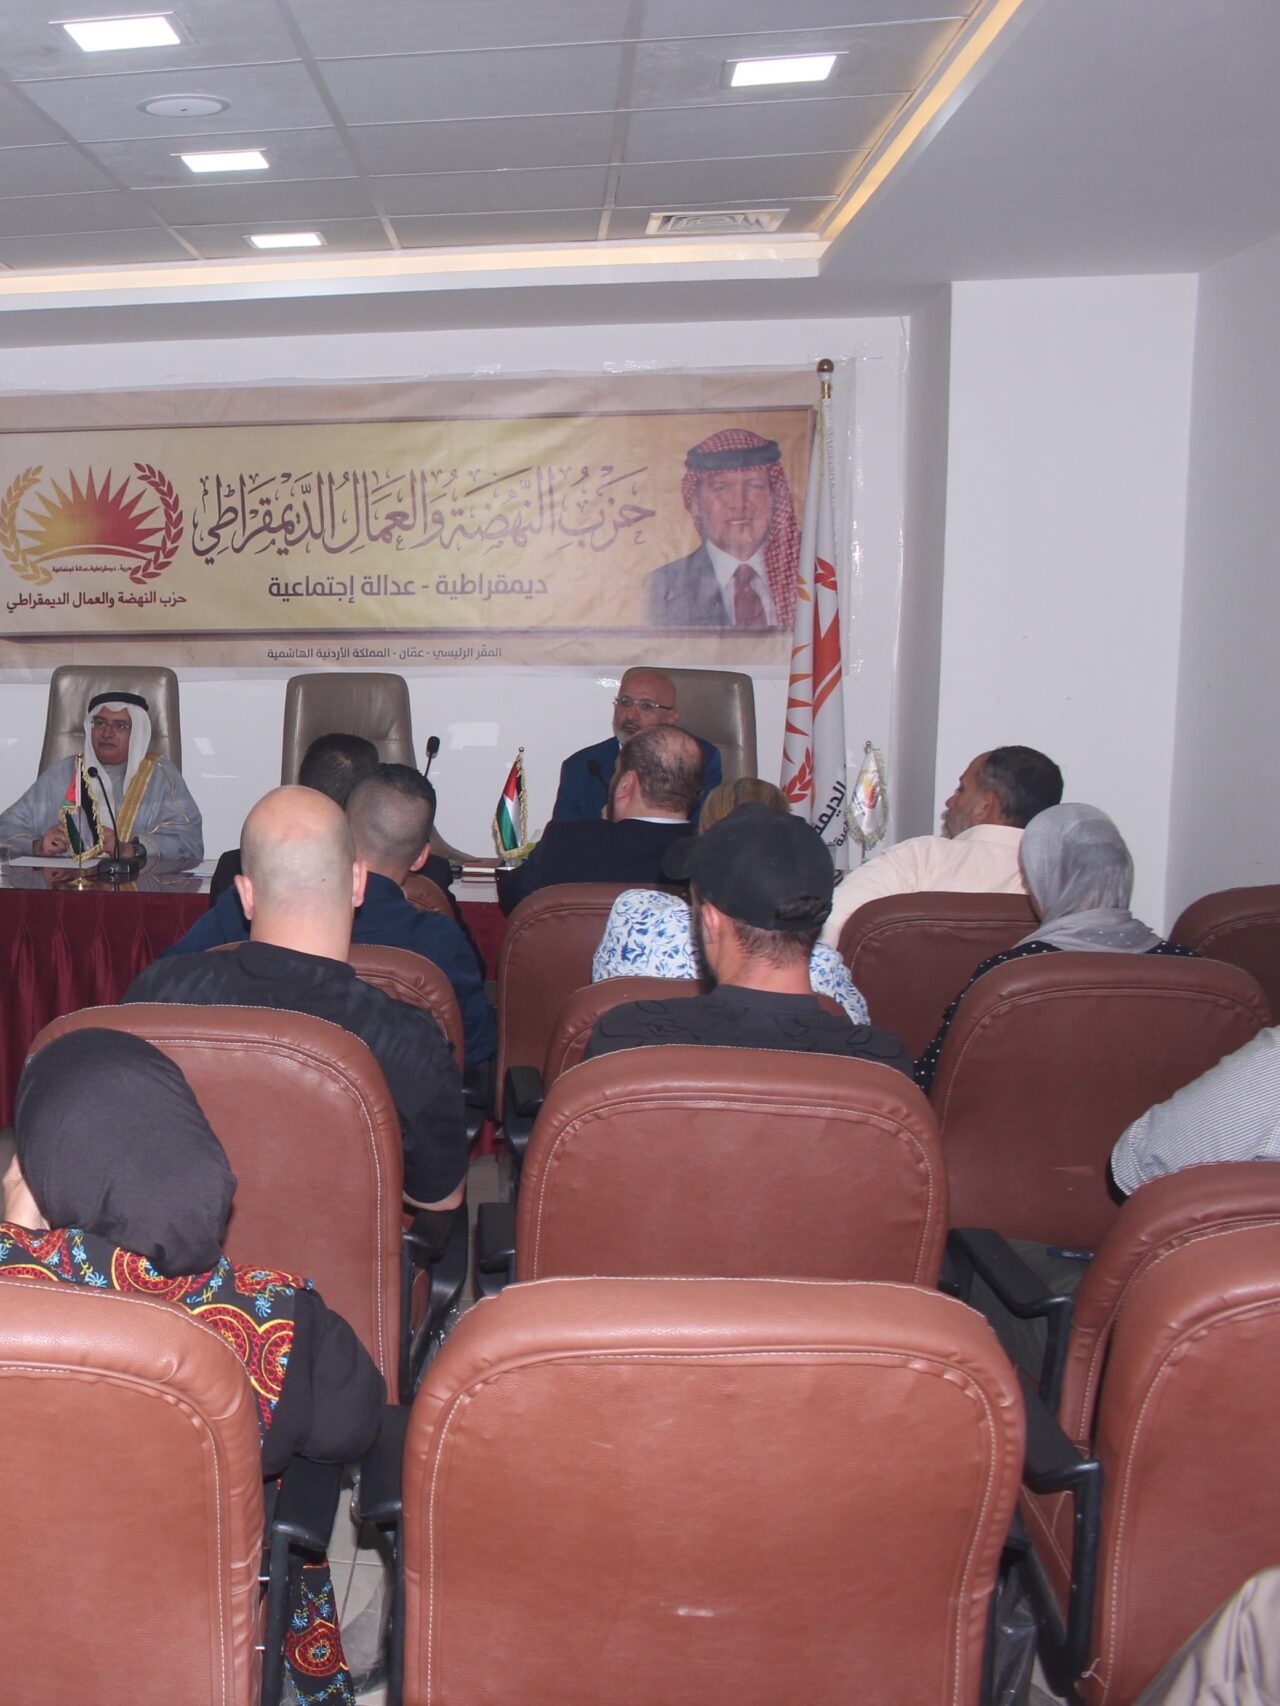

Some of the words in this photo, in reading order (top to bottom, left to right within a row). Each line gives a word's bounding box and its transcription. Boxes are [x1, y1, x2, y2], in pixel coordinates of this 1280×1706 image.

[267, 574, 355, 604] إجتماعية
[360, 574, 417, 597] عدالة
[435, 573, 548, 601] ديمقراطية
[6, 592, 70, 613] الديمقراطي
[72, 592, 115, 608] والعمال
[118, 591, 157, 608] النهضة
[159, 591, 187, 607] حزب
[267, 647, 313, 661] الهاشمية
[316, 646, 350, 660] الأردنية
[353, 647, 390, 659] المملكة
[432, 647, 473, 660] الرئيسي
